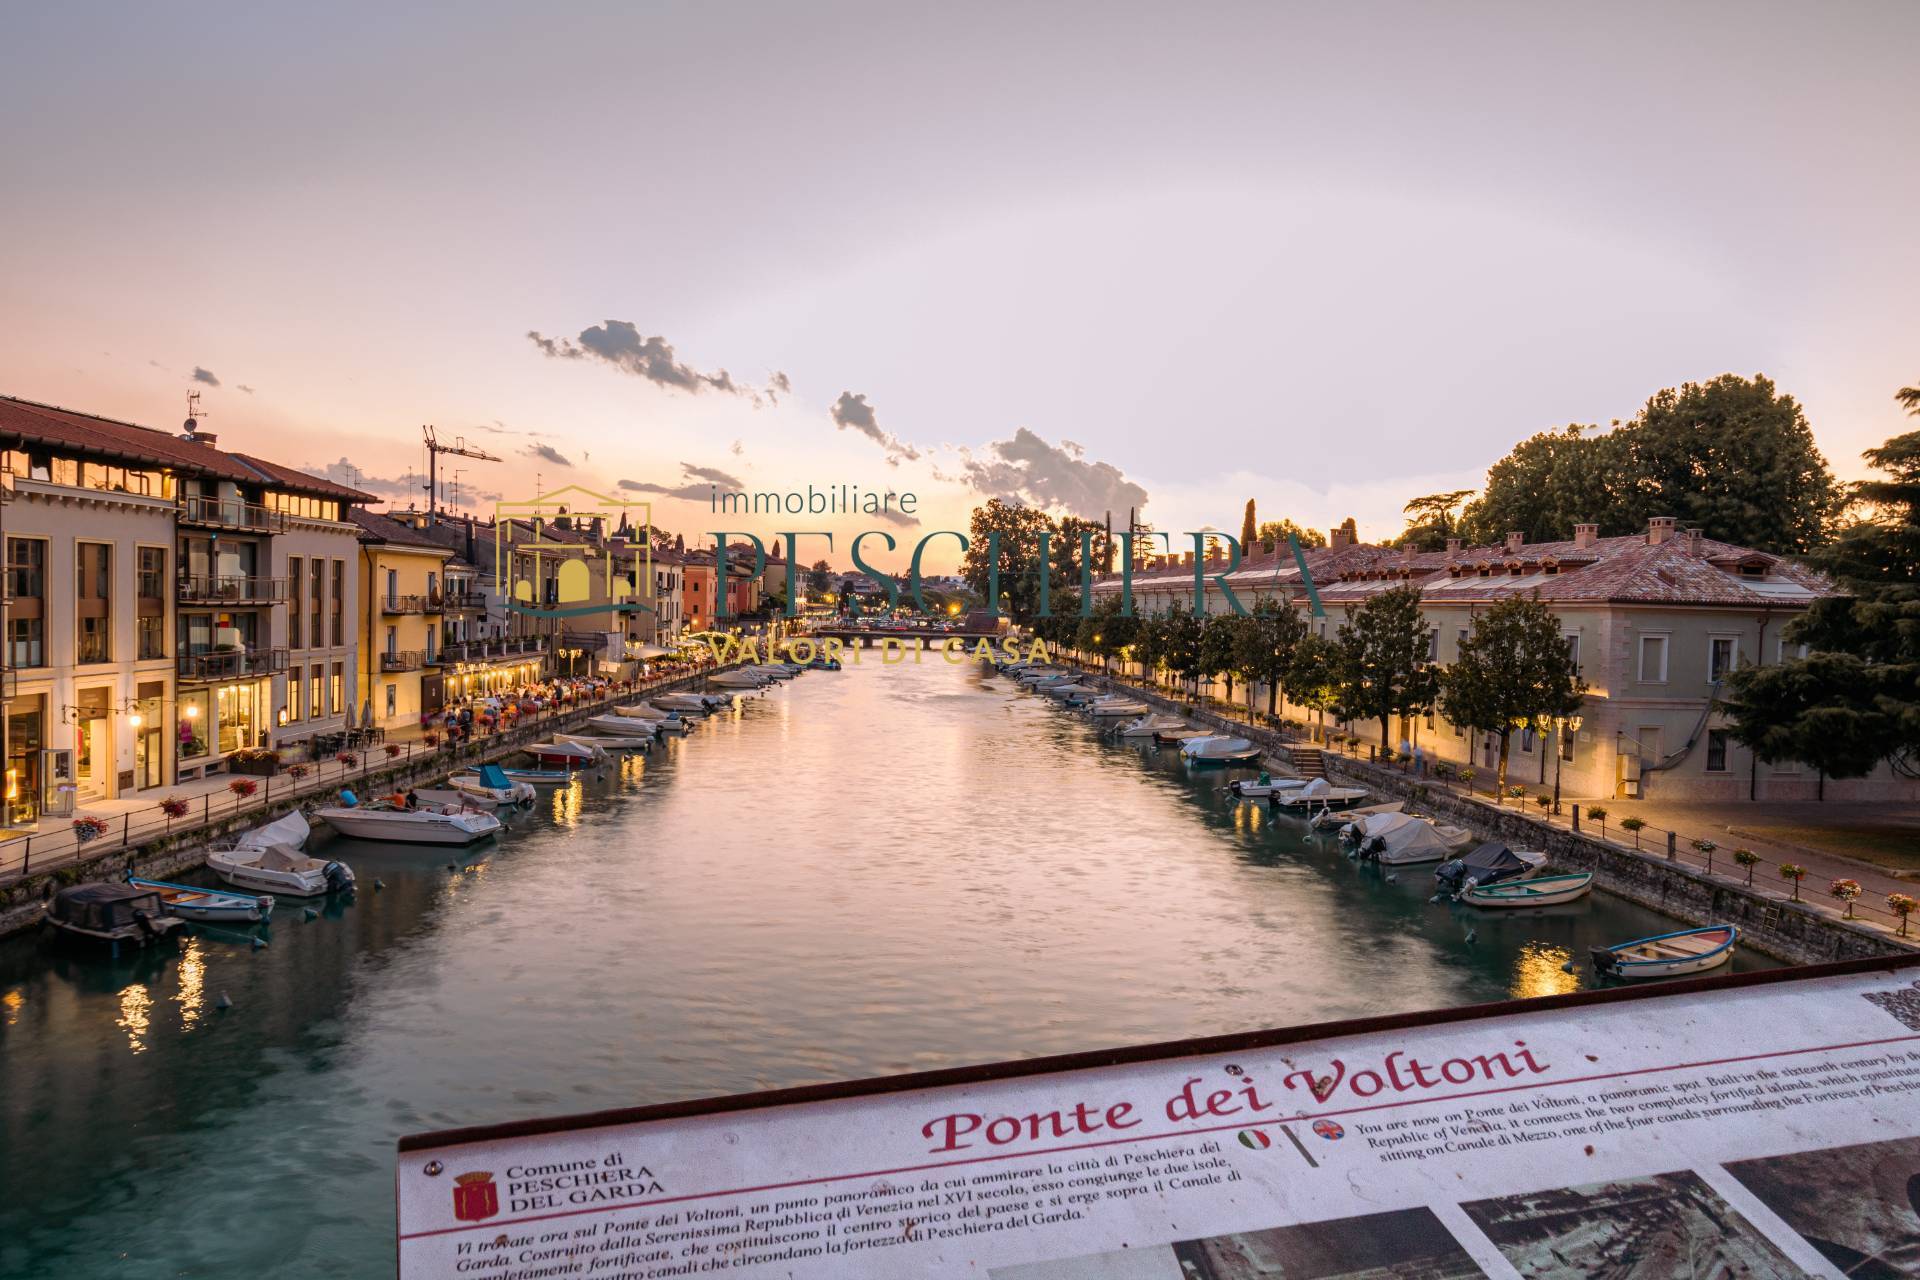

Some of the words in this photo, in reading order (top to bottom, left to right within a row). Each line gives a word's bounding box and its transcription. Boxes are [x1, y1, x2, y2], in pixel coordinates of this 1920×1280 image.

[921, 1101, 1143, 1153] Ponte
[1165, 1077, 1273, 1122] dei
[1283, 1040, 1550, 1104] Voltoni
[1355, 1124, 1383, 1135] You
[1386, 1121, 1408, 1130] are
[1412, 1116, 1440, 1127] now
[1444, 1114, 1462, 1122] on
[1464, 1107, 1505, 1120] Ponte
[1509, 1102, 1530, 1113] dei
[1533, 1095, 1585, 1110] Voltoni,
[1587, 1095, 1597, 1103] a
[1600, 1084, 1669, 1104] panoramic
[1741, 1073, 1757, 1082] in
[1757, 1069, 1778, 1081] the
[1781, 1062, 1839, 1077] sixteenth
[1841, 1057, 1888, 1070] century
[1906, 1051, 1920, 1061] th
[1367, 1131, 1429, 1149] Republic
[1433, 1127, 1448, 1141] of
[1508, 1119, 1520, 1128] it
[1523, 1112, 1582, 1126] connects
[1584, 1107, 1607, 1118] the
[1609, 1105, 1634, 1114] two
[1638, 1093, 1709, 1111] completely
[1710, 1084, 1765, 1103] fortified
[1819, 1073, 1859, 1086] which
[1379, 1149, 1427, 1162] sitting
[1427, 1146, 1444, 1155] on
[1443, 1137, 1496, 1154] Canale
[1497, 1134, 1512, 1146] di
[1512, 1131, 1562, 1144] Mezzo,
[1563, 1126, 1588, 1136] one
[1589, 1121, 1604, 1135] of
[1604, 1119, 1626, 1131] the
[1627, 1116, 1655, 1130] four
[1657, 1109, 1701, 1123] canals
[1701, 1098, 1783, 1117] surrounding
[1782, 1096, 1804, 1110] the
[1803, 1089, 1861, 1103] Fortress
[1859, 1085, 1875, 1098] of
[1871, 1081, 1920, 1094] Peschie
[458, 1242, 472, 1255] Vi
[478, 1234, 534, 1252] trovate
[540, 1232, 568, 1243] ora
[573, 1223, 597, 1239] sul
[604, 1220, 649, 1234] Ponte
[655, 1213, 678, 1227] dei
[686, 1205, 744, 1223] Voltoni,
[750, 1204, 769, 1215] un
[775, 1197, 818, 1214] punto
[824, 1183, 914, 1208] panoramico
[920, 1180, 939, 1192] da
[944, 1176, 966, 1189] cui
[972, 1168, 1043, 1185] ammirare
[1049, 1163, 1062, 1175] la
[1067, 1158, 1100, 1172] città
[1105, 1155, 1118, 1168] di
[1124, 1148, 1195, 1165] Peschiera
[1199, 1141, 1221, 1154] del
[506, 1160, 597, 1179] Comune
[604, 1152, 623, 1167] di
[509, 1166, 655, 1196] PESCHIERA
[510, 1196, 563, 1213] DEL
[569, 1181, 665, 1203] GARDA
[519, 1244, 596, 1263] Costruito
[599, 1235, 641, 1252] dalla
[645, 1224, 740, 1245] Serenissima
[745, 1211, 832, 1233] Repubblica
[836, 1206, 851, 1222] di
[856, 1200, 913, 1216] Venezia
[917, 1194, 940, 1208] nel
[944, 1190, 972, 1205] XVI
[977, 1184, 1029, 1201] secolo,
[1032, 1181, 1064, 1192] esso
[1068, 1171, 1143, 1188] congiunge
[1147, 1166, 1160, 1177] le
[1164, 1163, 1189, 1175] due
[1192, 1157, 1231, 1171] isole,
[587, 1250, 673, 1274] fortificate,
[681, 1243, 709, 1257] che
[716, 1229, 820, 1253] costituiscono
[827, 1224, 836, 1237] il
[843, 1220, 892, 1234] centro
[898, 1212, 951, 1230] storico
[957, 1204, 981, 1219] del
[985, 1202, 1029, 1219] paese
[1035, 1200, 1043, 1208] e
[1049, 1194, 1062, 1206] si
[1068, 1192, 1100, 1205] erge
[1106, 1185, 1148, 1200] sopra
[1154, 1180, 1164, 1192] il
[1169, 1173, 1221, 1190] Canale
[1227, 1170, 1242, 1182] di
[647, 1260, 698, 1279] canali
[701, 1257, 729, 1272] che
[732, 1246, 822, 1267] circondano
[826, 1241, 841, 1254] la
[842, 1233, 907, 1255] fortezza
[909, 1229, 923, 1243] di
[927, 1221, 1004, 1240] Peschiera
[1006, 1214, 1029, 1229] del
[1032, 1209, 1085, 1224] Garda.
